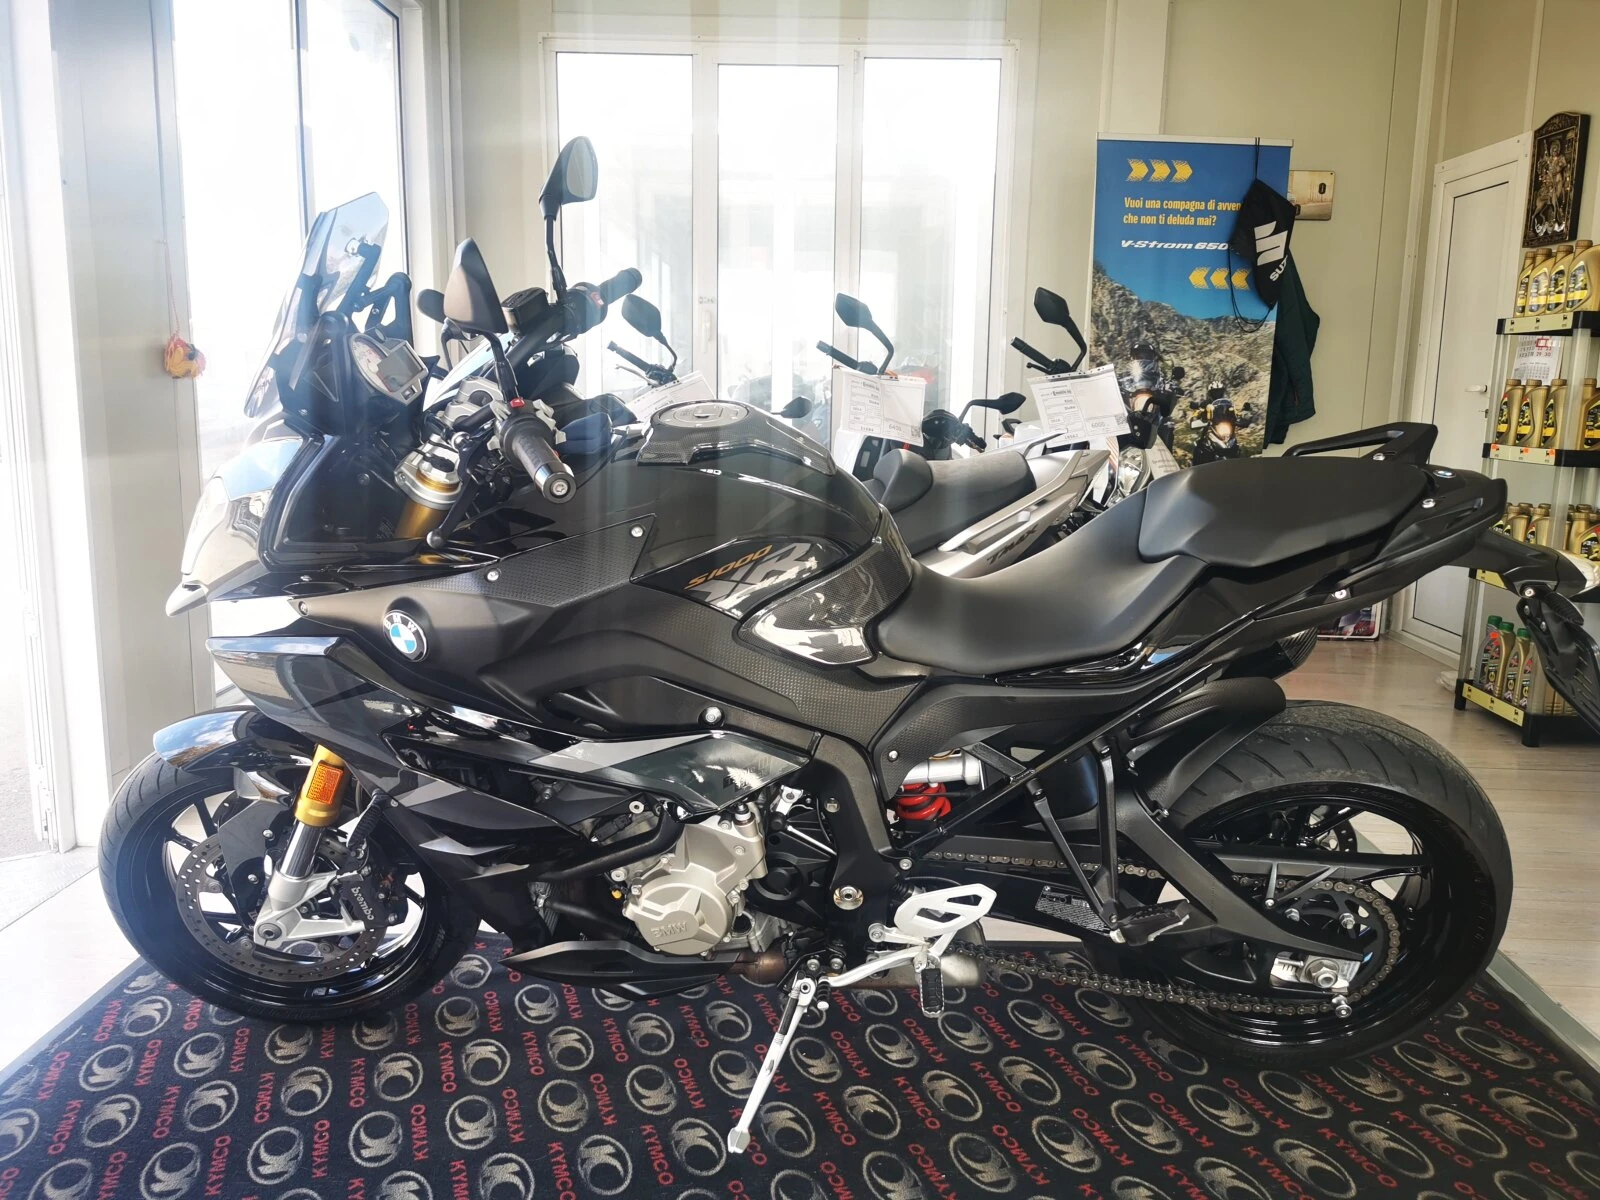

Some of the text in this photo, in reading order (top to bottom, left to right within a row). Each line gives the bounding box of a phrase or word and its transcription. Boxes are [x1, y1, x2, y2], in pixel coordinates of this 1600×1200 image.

[1123, 212, 1217, 226] che non ti deluda mai?
[1124, 197, 1242, 212] Vuoi una compagna di avven
[1121, 239, 1229, 250] V-Strom 650
[1269, 254, 1289, 281] SUZ
[684, 544, 773, 589] S1000
[384, 614, 418, 633] BMW
[351, 886, 375, 921] brembo
[650, 920, 689, 938] BMW
[184, 999, 203, 1031] MCO
[483, 991, 503, 1033] KYMCO
[562, 983, 582, 1020] KYMC
[755, 993, 780, 1032] KYMC
[832, 991, 861, 1023] YMCO
[230, 1028, 250, 1072] KYMCO
[320, 1025, 335, 1059] KYMC
[603, 1018, 630, 1064] KYMCO
[680, 1004, 710, 1049] KYMCO
[903, 1018, 945, 1064] KYMCO
[974, 1006, 1019, 1050] KYMCO
[136, 1039, 162, 1087] KYMCO
[439, 1041, 458, 1094] KYMCO
[522, 1030, 545, 1077] KYMCO
[831, 1031, 870, 1079] KYMCO
[1046, 1047, 1100, 1096] KYMCO
[1118, 1035, 1172, 1081] KYMCO
[1370, 1054, 1433, 1096] KYMC
[253, 1072, 273, 1124] KYMCO
[348, 1057, 367, 1109] KYMCO
[589, 1072, 617, 1126] KYMCO
[673, 1057, 706, 1110] KYMCO
[895, 1076, 942, 1131] KYMCO
[972, 1061, 1022, 1114] KYMCO
[1223, 1077, 1290, 1130] KYMCO
[48, 1100, 81, 1155] KYMCO
[152, 1086, 180, 1140] KYMCO
[410, 1104, 428, 1161] KYMCO
[501, 1088, 525, 1144] KYMCO
[814, 1091, 858, 1148] KYMCO
[1072, 1107, 1134, 1167] KYMCO
[1148, 1091, 1215, 1148] KYMCO
[1463, 1094, 1545, 1149] KYMCO
[311, 1119, 331, 1179] KYMCO
[641, 1124, 675, 1186] KYMCO
[991, 1124, 1049, 1186] KYMCO
[1319, 1127, 1399, 1189] KYMCO
[1392, 1110, 1473, 1167] KYMCO
[206, 1135, 232, 1196] KYMCO
[450, 1159, 470, 1200] KYM
[818, 1160, 853, 1200] MCO
